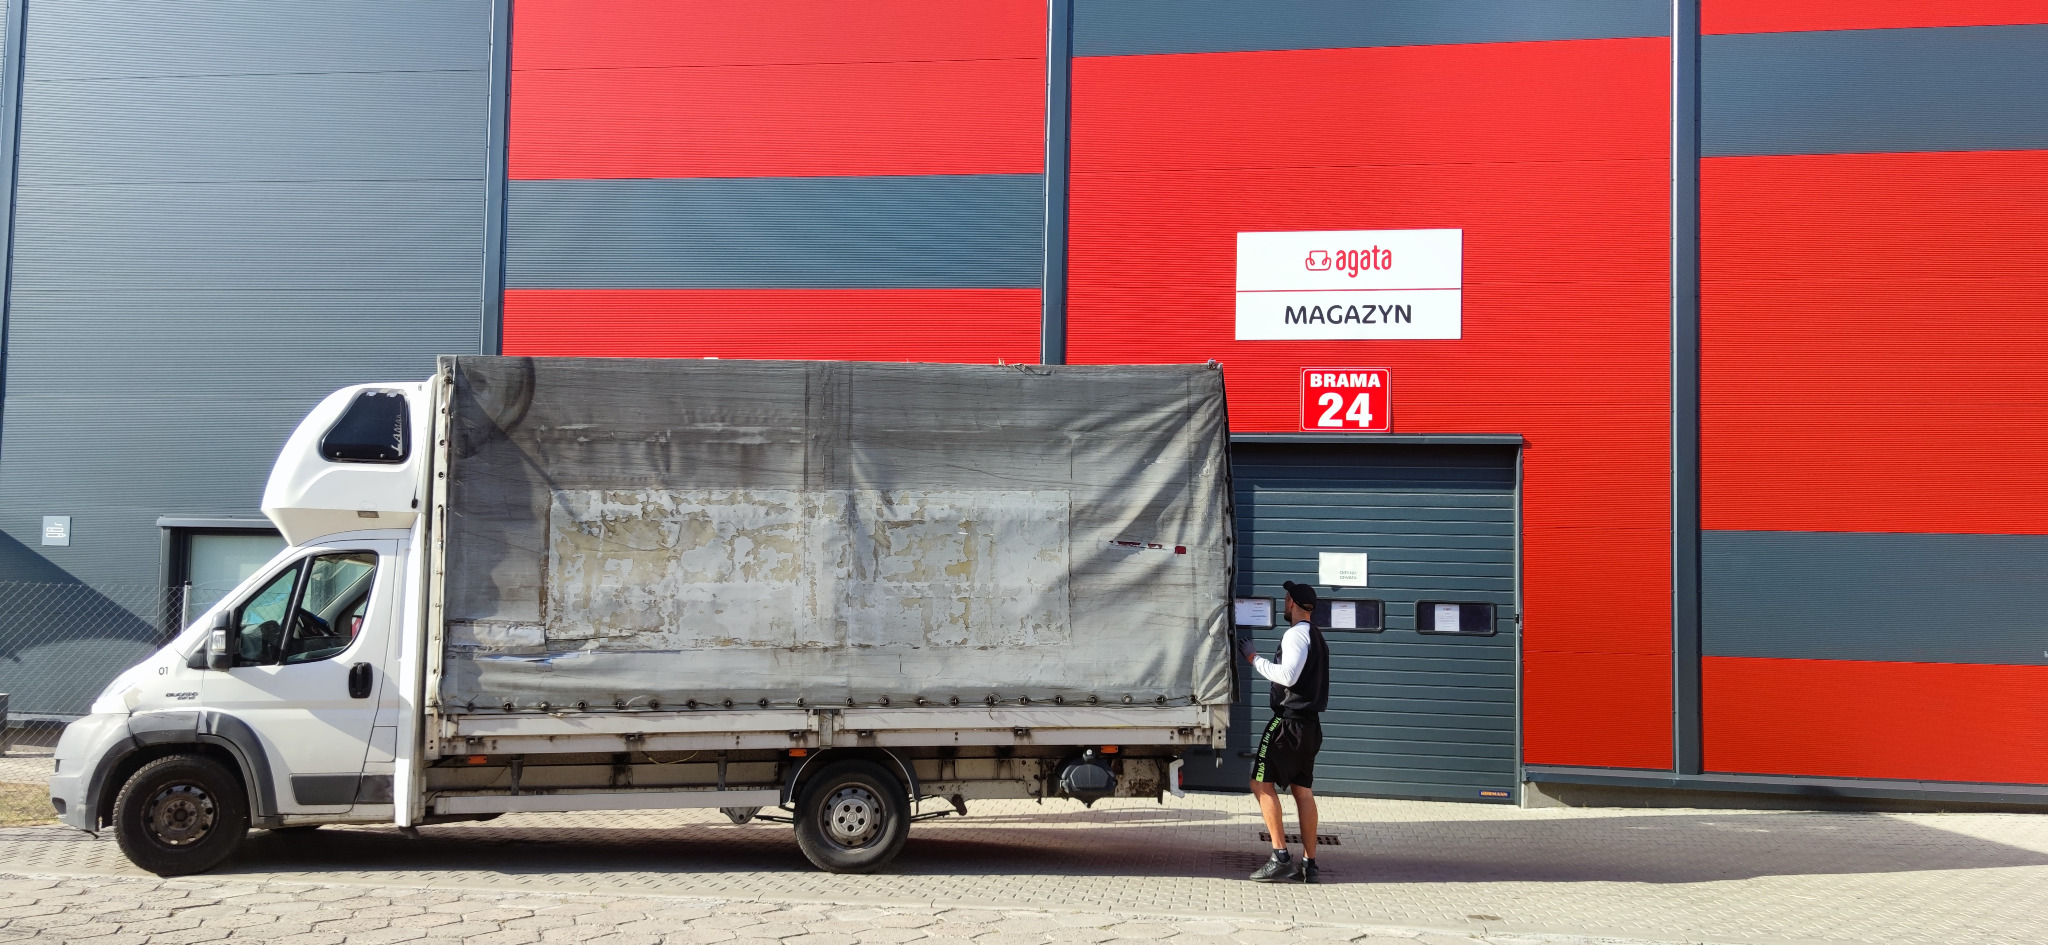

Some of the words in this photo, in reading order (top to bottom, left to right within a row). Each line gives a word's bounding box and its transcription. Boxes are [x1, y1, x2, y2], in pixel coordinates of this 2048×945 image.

[1335, 245, 1392, 278] agata
[1284, 304, 1412, 325] MAGAZYN
[1310, 374, 1381, 388] BRAMA
[1317, 392, 1373, 428] 24
